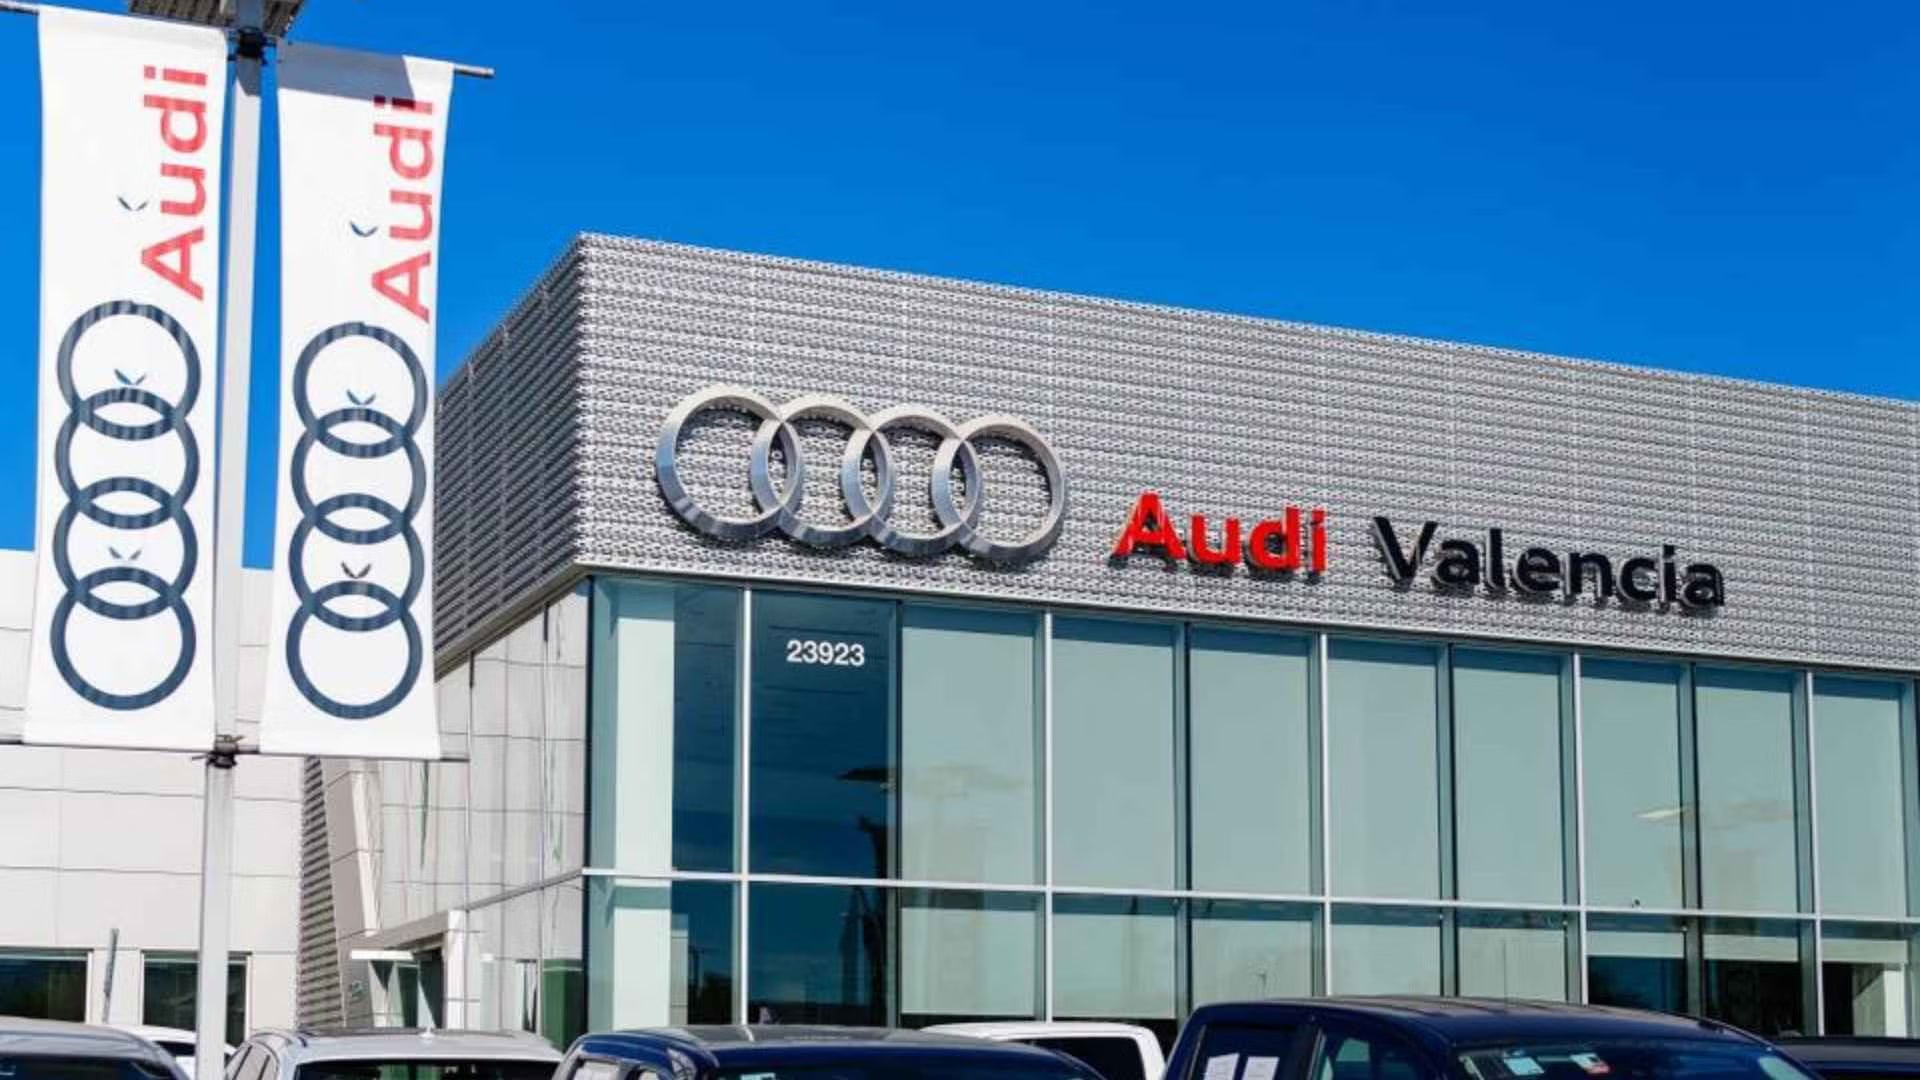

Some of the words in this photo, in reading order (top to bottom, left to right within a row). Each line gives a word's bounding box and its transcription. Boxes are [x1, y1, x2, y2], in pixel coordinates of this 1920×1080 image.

[140, 65, 208, 301] Audi
[371, 95, 433, 323] Audi
[1111, 491, 1327, 574] Audi
[1373, 515, 1726, 607] Valencia
[786, 639, 866, 667] 23923
